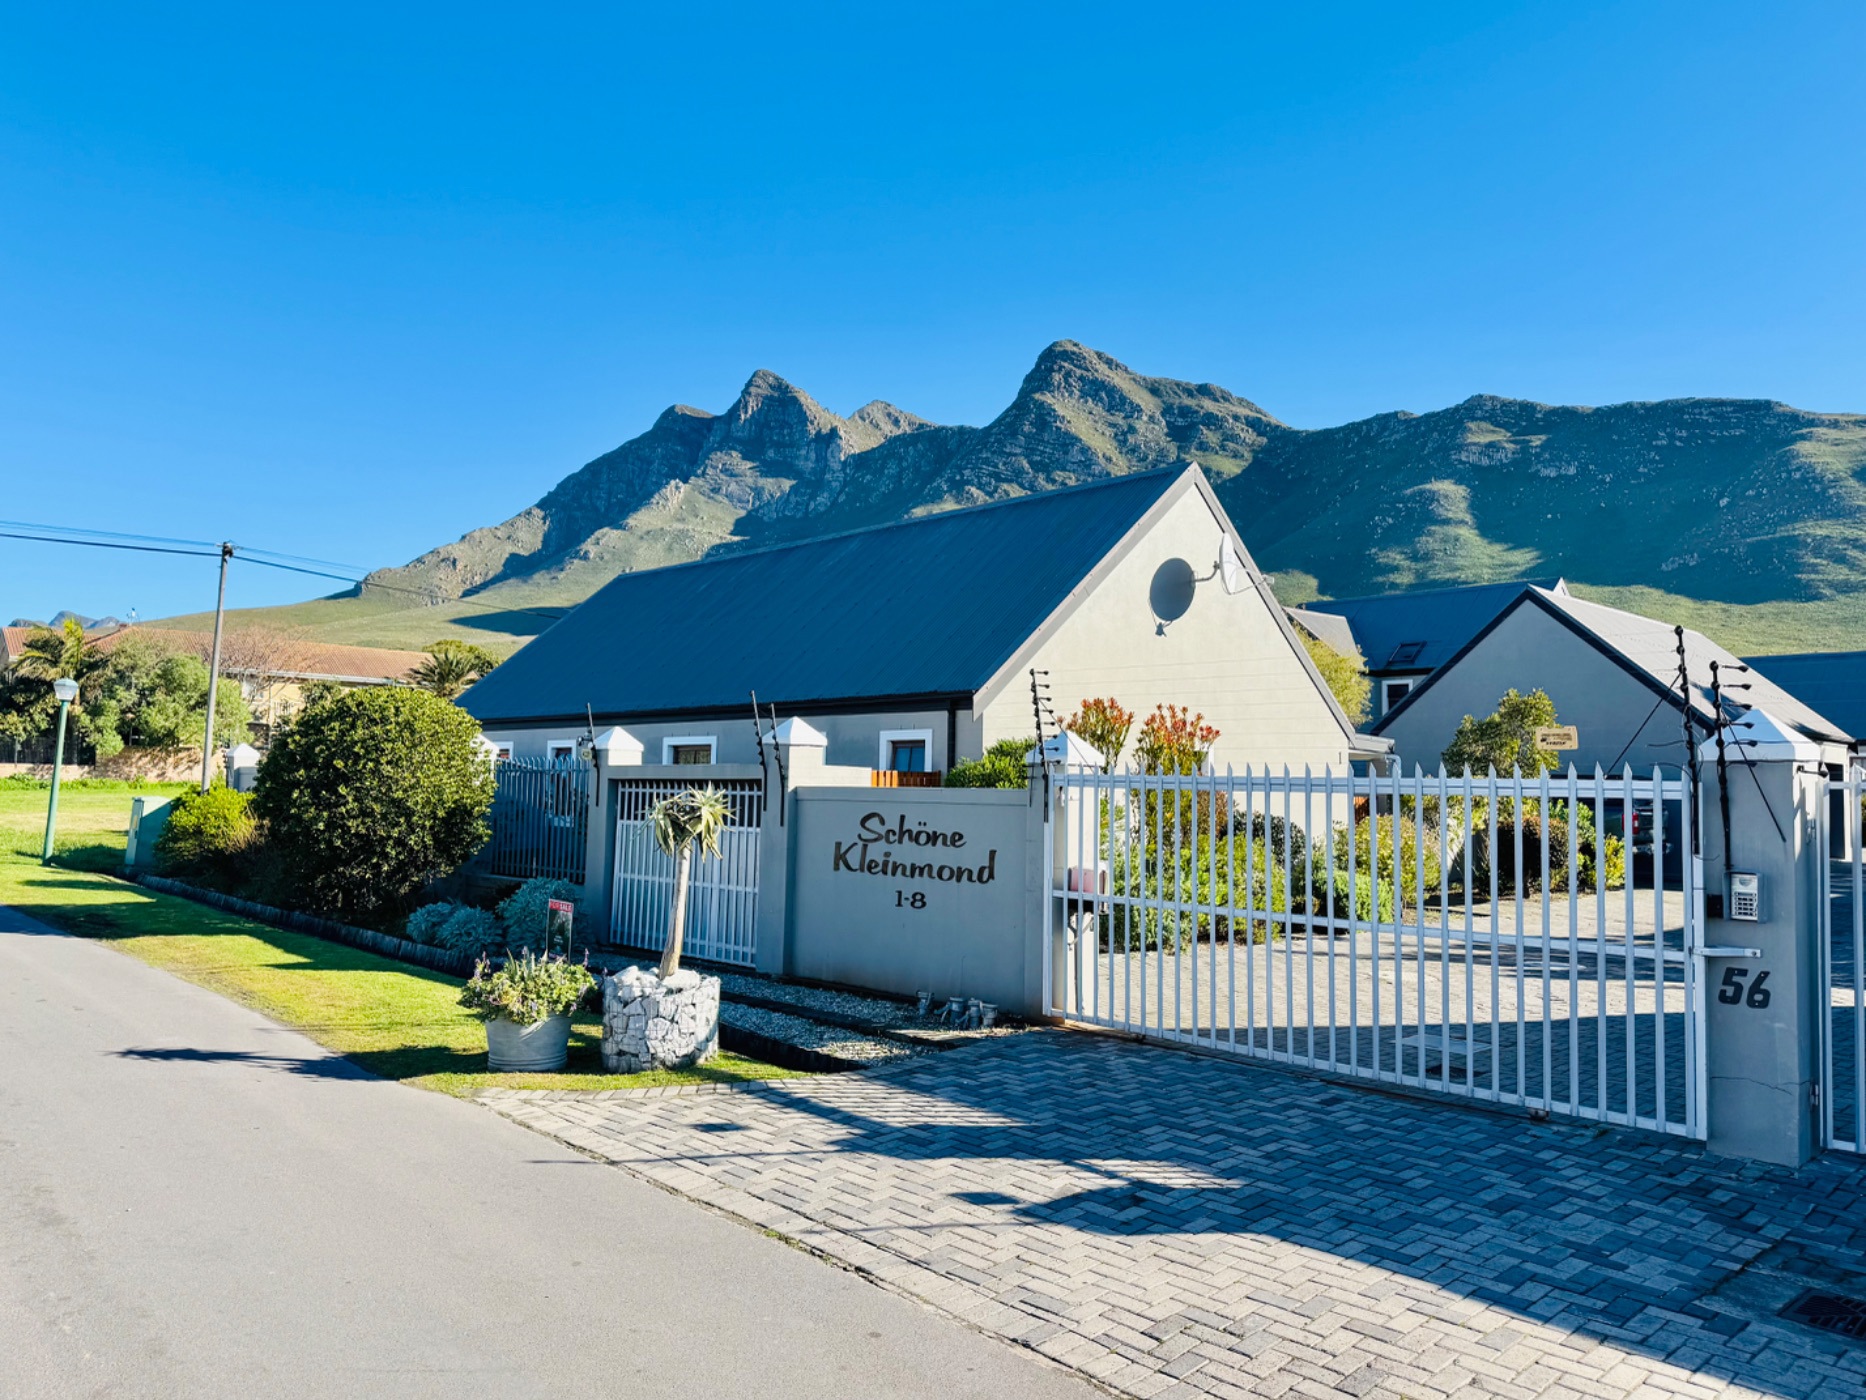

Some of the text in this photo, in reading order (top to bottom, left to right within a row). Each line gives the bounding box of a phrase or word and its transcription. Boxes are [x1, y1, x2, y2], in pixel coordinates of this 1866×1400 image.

[857, 812, 967, 848] Schöne
[833, 841, 998, 885] Kleinmond
[895, 890, 927, 909] 1-8
[1718, 966, 1771, 1009] 56
